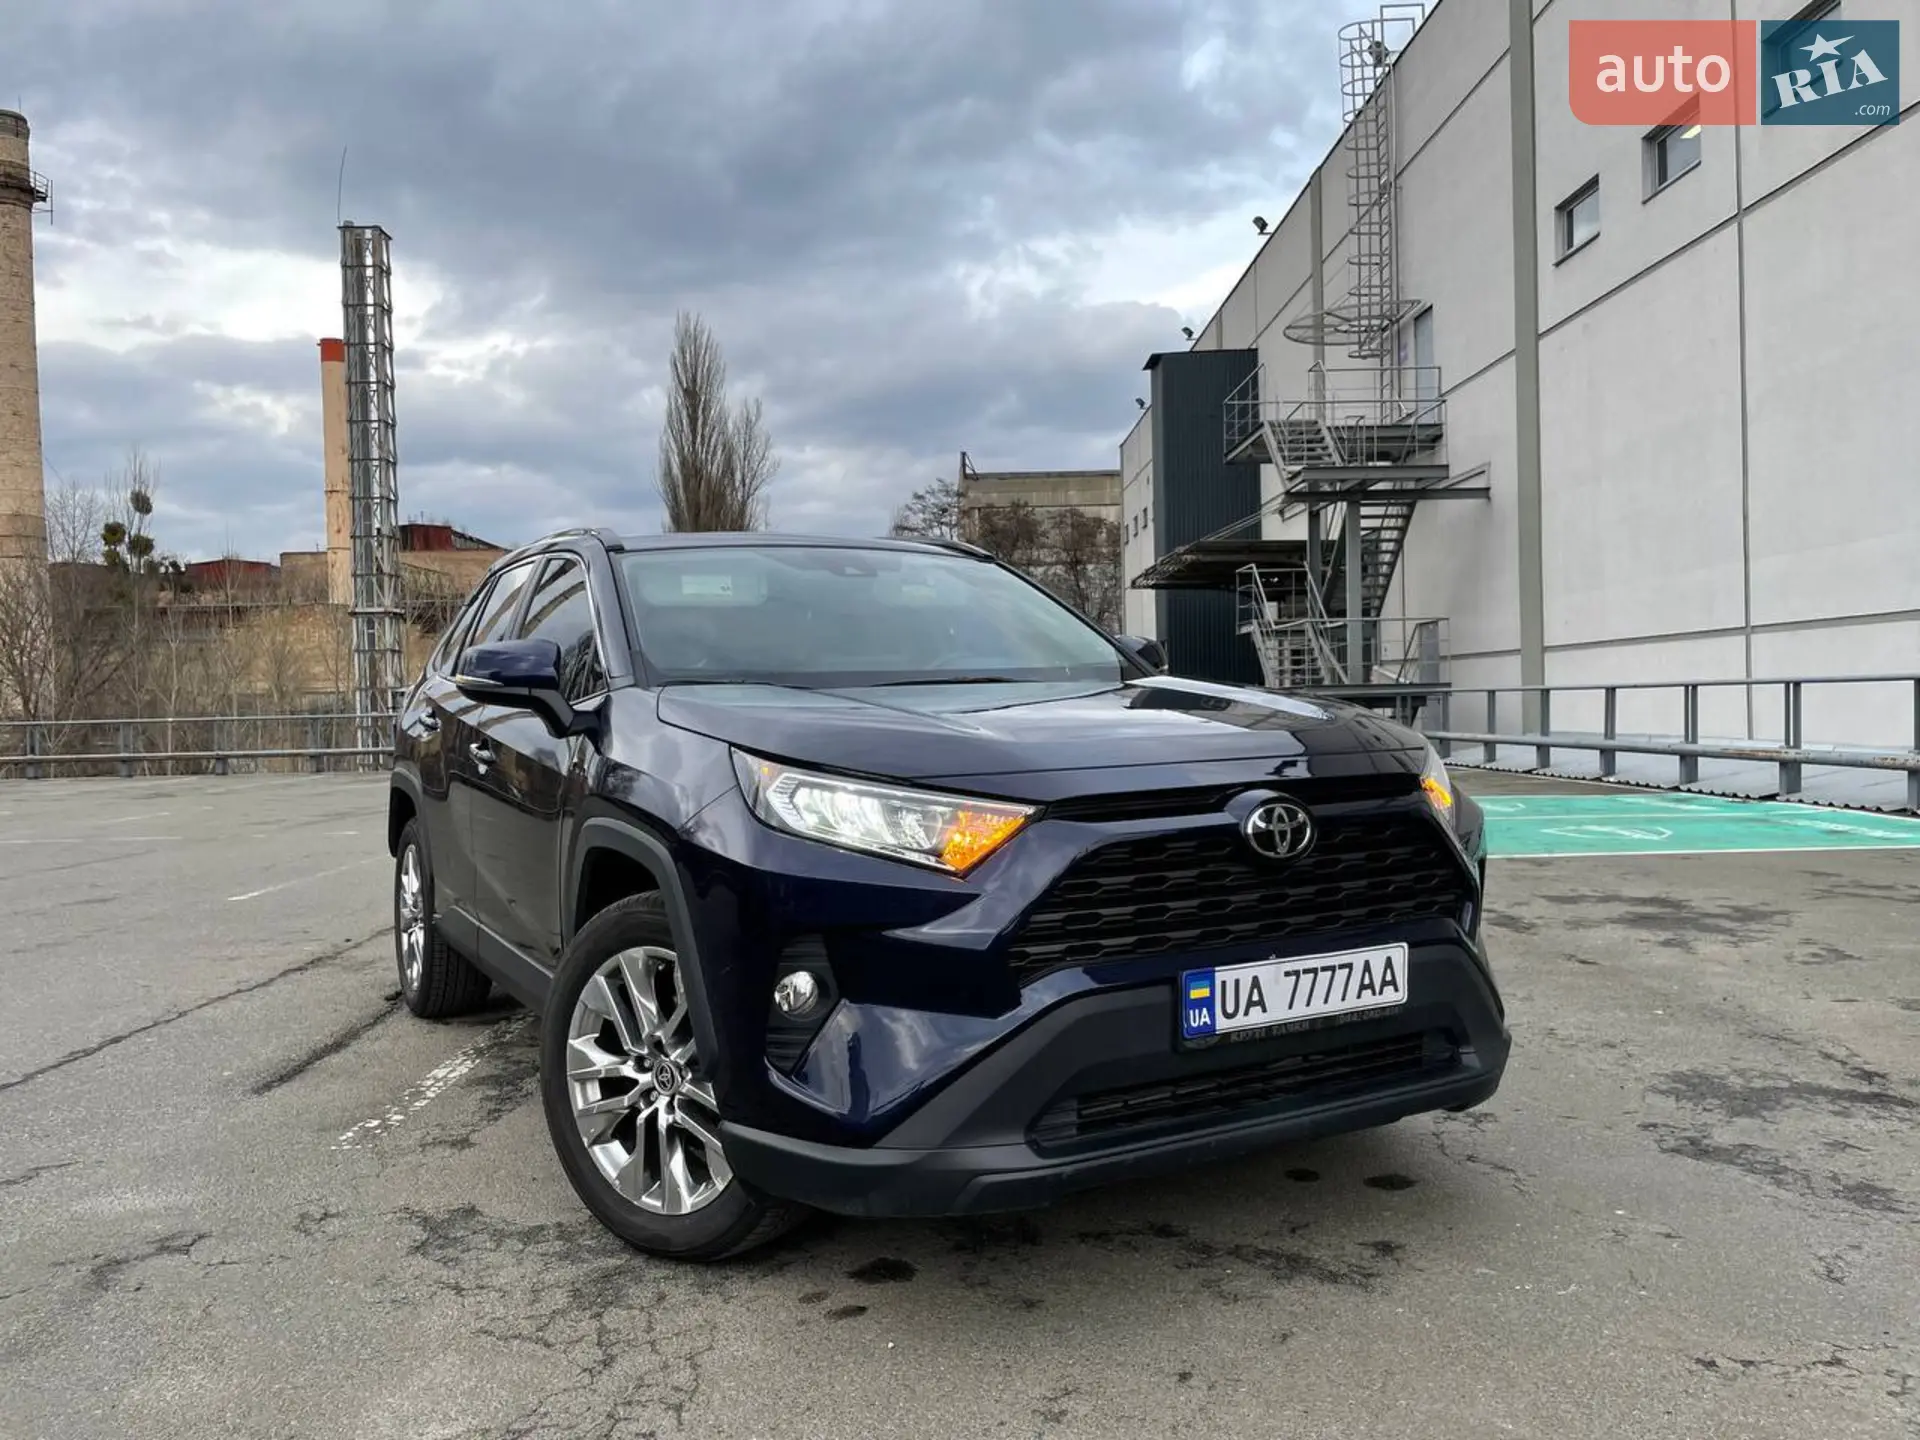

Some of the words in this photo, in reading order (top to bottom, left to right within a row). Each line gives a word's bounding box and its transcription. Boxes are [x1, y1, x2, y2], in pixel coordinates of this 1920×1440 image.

[1220, 975, 1267, 1020] UA
[1284, 956, 1399, 1010] 7777AA
[1190, 1007, 1211, 1027] UA
